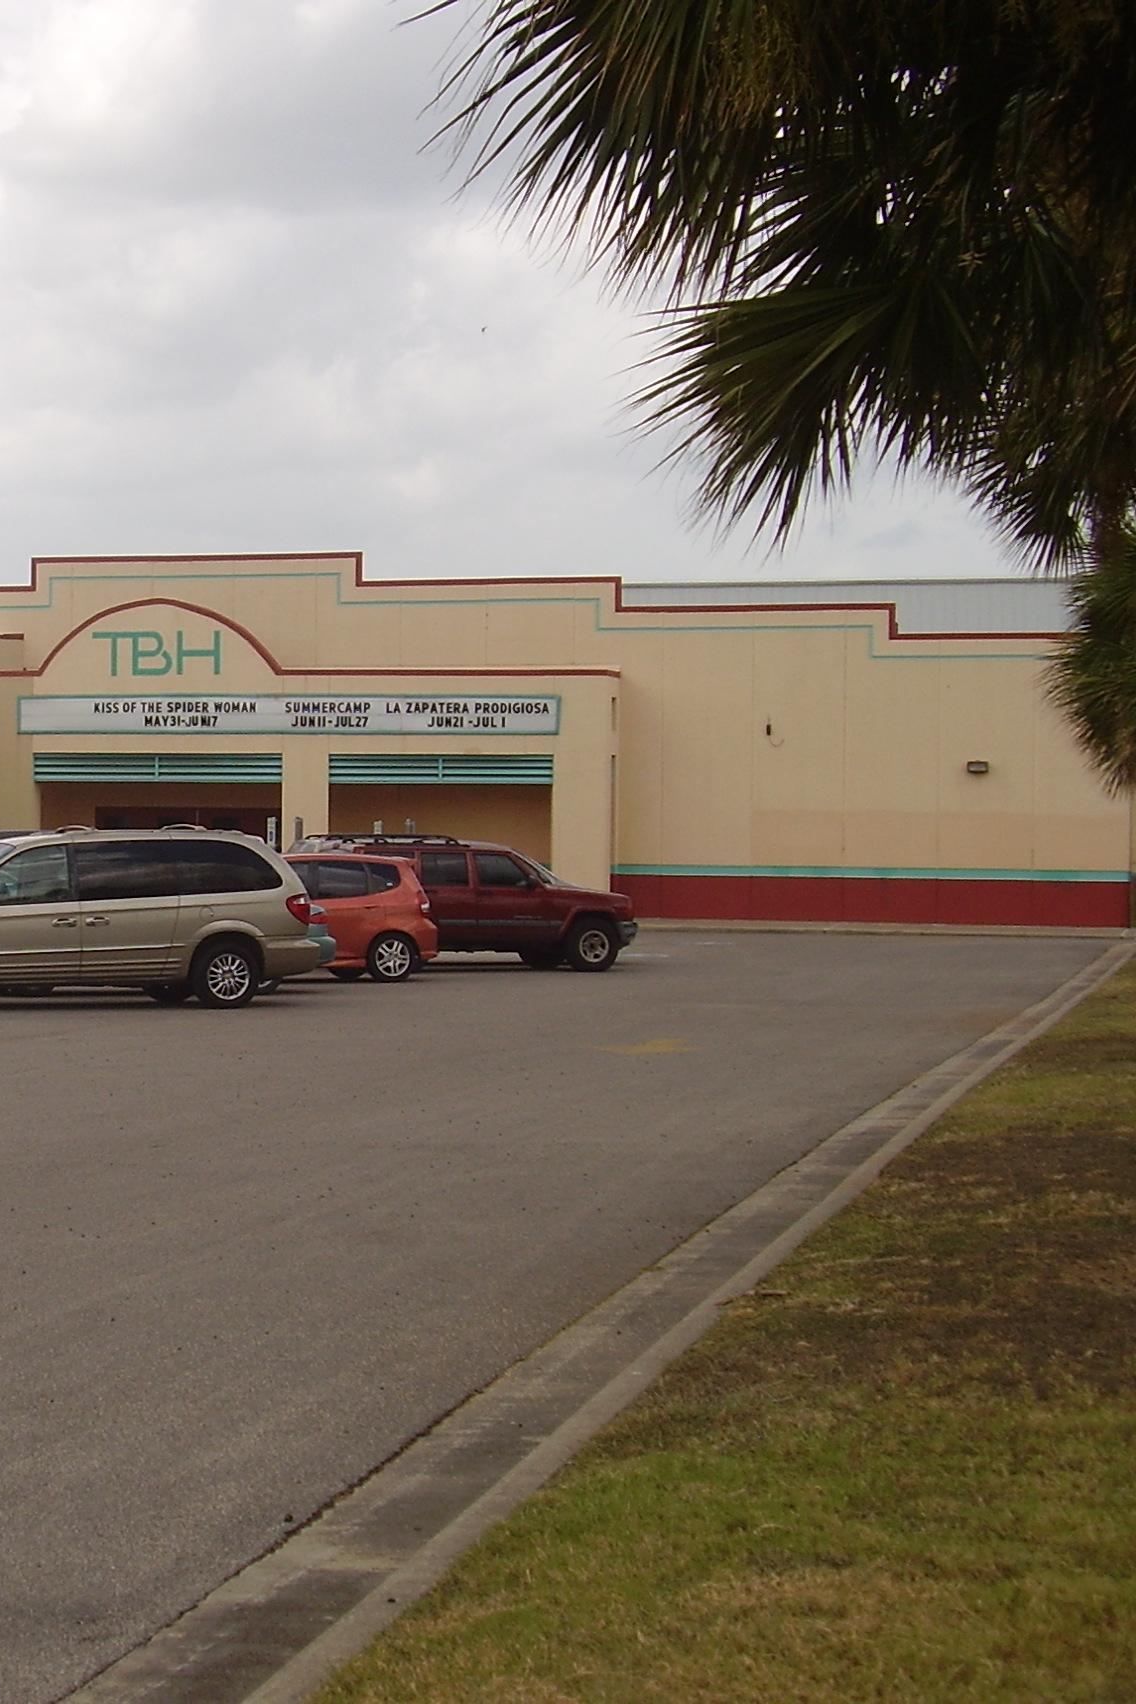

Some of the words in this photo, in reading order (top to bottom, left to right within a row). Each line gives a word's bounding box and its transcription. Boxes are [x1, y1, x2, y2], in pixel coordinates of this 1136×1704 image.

[92, 630, 221, 676] TBH
[93, 701, 119, 714] KISS
[122, 701, 137, 714] OF
[141, 701, 163, 714] THE
[167, 701, 210, 714] SPIDER
[214, 701, 257, 714] WOMAN
[285, 701, 371, 714] SUMMERCAMP
[385, 702, 401, 714] LA
[405, 702, 470, 714] ZAPATERA
[474, 702, 550, 714] PRODIGIOSA
